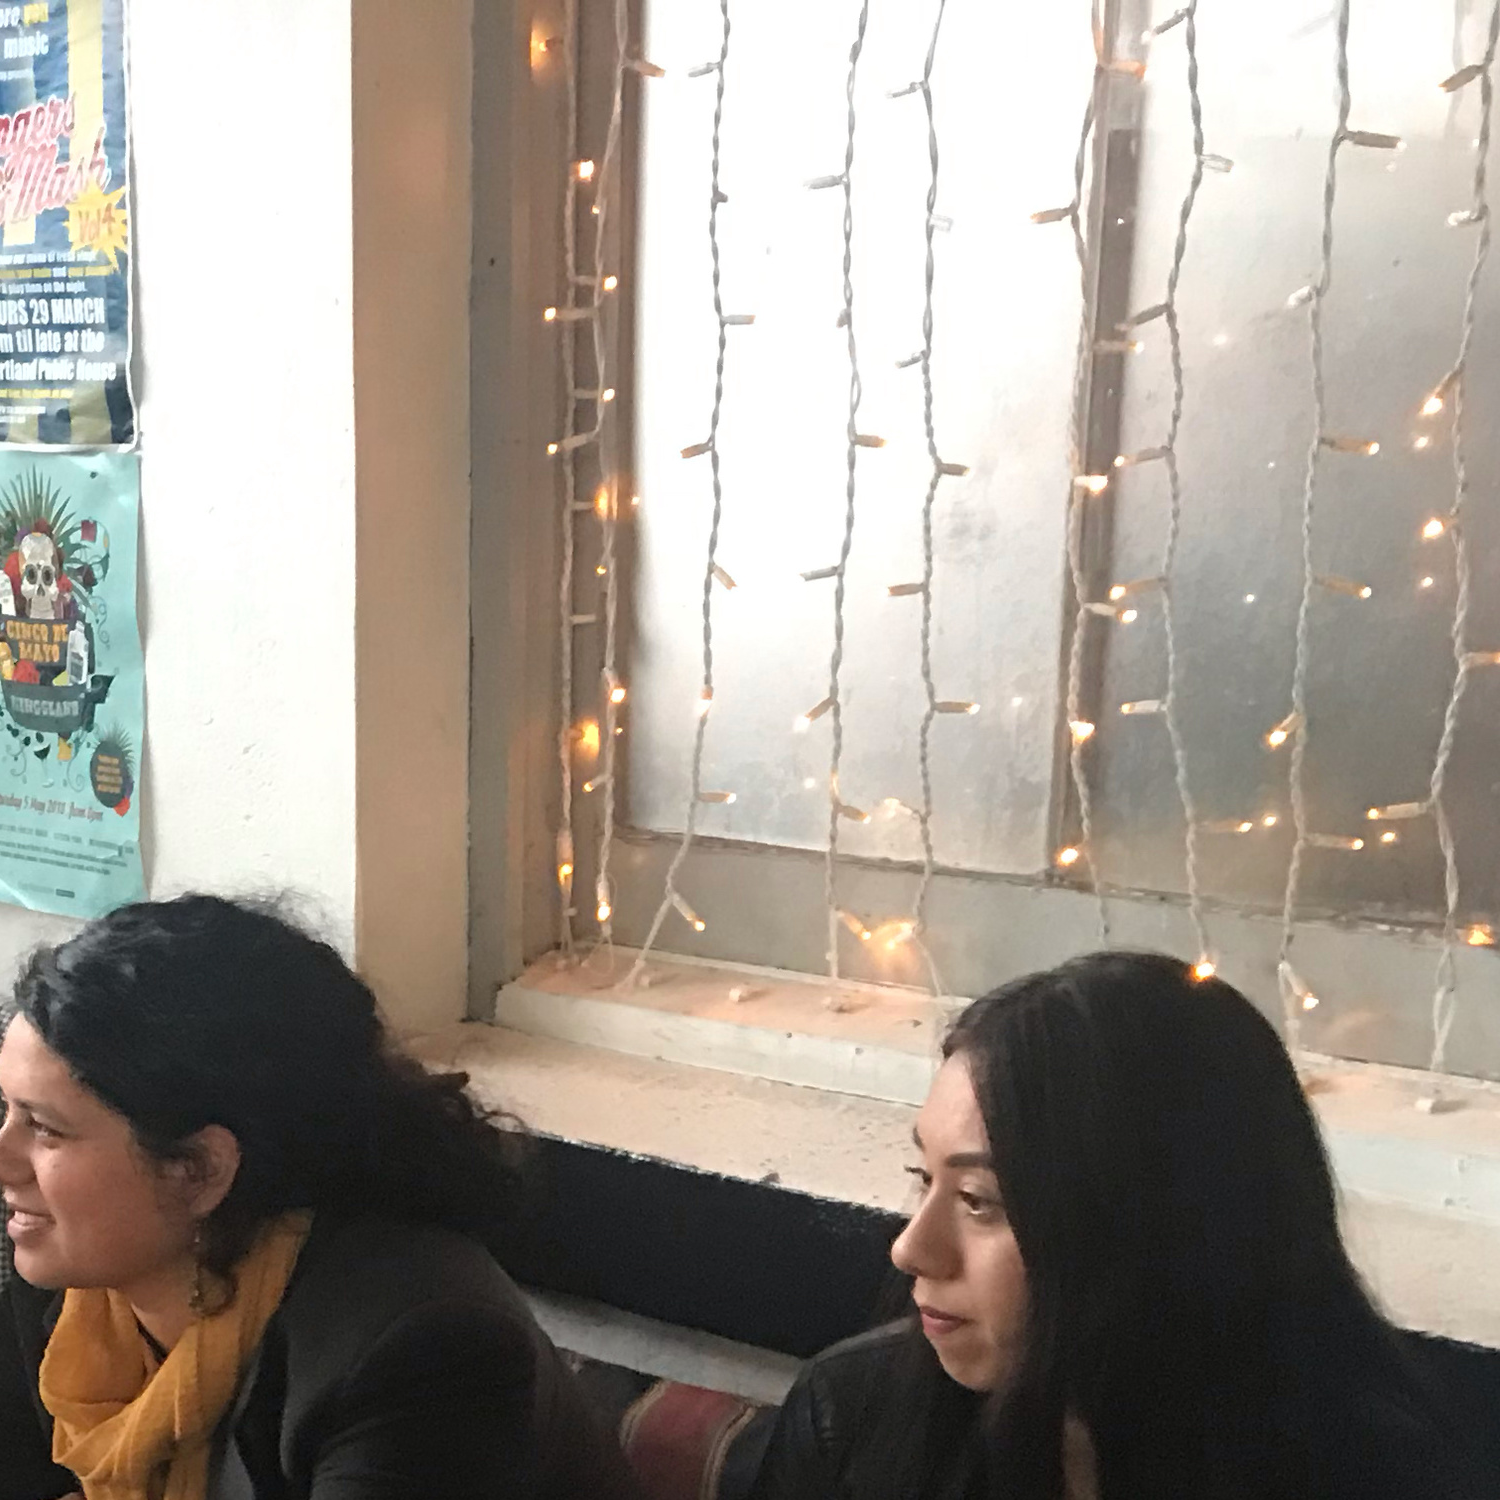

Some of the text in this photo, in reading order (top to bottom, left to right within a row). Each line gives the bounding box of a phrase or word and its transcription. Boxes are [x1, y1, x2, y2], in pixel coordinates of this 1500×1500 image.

[3, 30, 49, 59] music
[30, 299, 49, 325] 29
[51, 298, 106, 325] MARCH
[16, 329, 32, 352] til
[35, 329, 62, 353] late
[64, 330, 79, 353] at
[81, 328, 105, 353] the
[38, 358, 75, 381] Public
[77, 359, 117, 382] House
[6, 620, 49, 643] CINCO
[18, 641, 60, 663] MAYO
